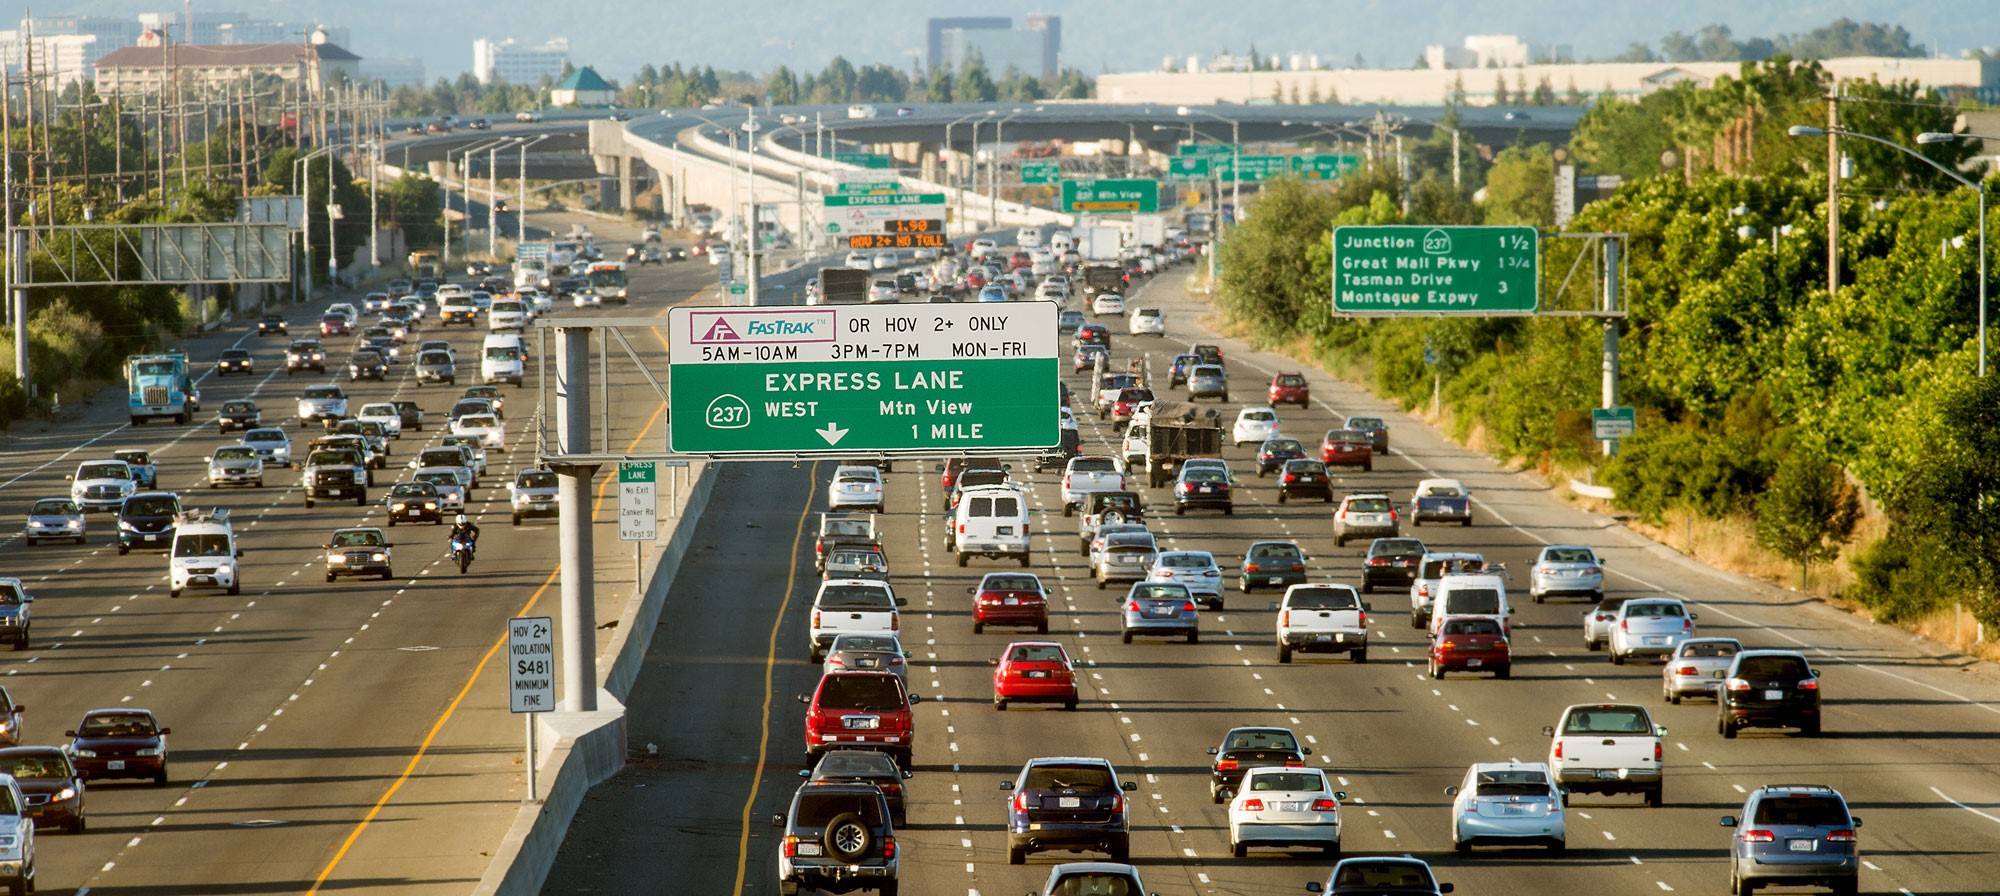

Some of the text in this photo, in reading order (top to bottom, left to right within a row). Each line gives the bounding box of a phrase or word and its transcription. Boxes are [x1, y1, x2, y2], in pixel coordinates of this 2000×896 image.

[848, 196, 920, 205] EXPRESS LANE
[1120, 190, 1142, 198] View
[876, 236, 892, 247] 2+
[896, 235, 911, 247] NO
[916, 234, 944, 246] TOLL
[1343, 236, 1415, 249] Junction
[1426, 238, 1448, 250] 237
[1499, 236, 1505, 249] 1
[1342, 256, 1388, 270] Great
[1396, 257, 1429, 270] Mall
[1438, 257, 1480, 272] Pkwy
[1499, 258, 1504, 270] 1
[1342, 274, 1453, 286] Tasman Drive
[1498, 282, 1508, 294] 3
[1342, 292, 1478, 306] Montague Expwy
[849, 316, 1008, 333] OR HOV 2+ ONLY
[702, 342, 1026, 361] 5AM-10AM 3PM-7PM MON-FRI
[765, 370, 964, 392] EXPRESS LANE
[712, 406, 744, 423] 237
[765, 400, 972, 418] WEST Mtn View
[912, 423, 984, 440] 1 MILE
[628, 471, 646, 480] LANE
[514, 624, 548, 638] HOV 2+
[512, 643, 550, 655] VIOLATION
[518, 659, 549, 675] $481
[516, 679, 548, 690] MINIMUM
[524, 694, 540, 706] FINE
